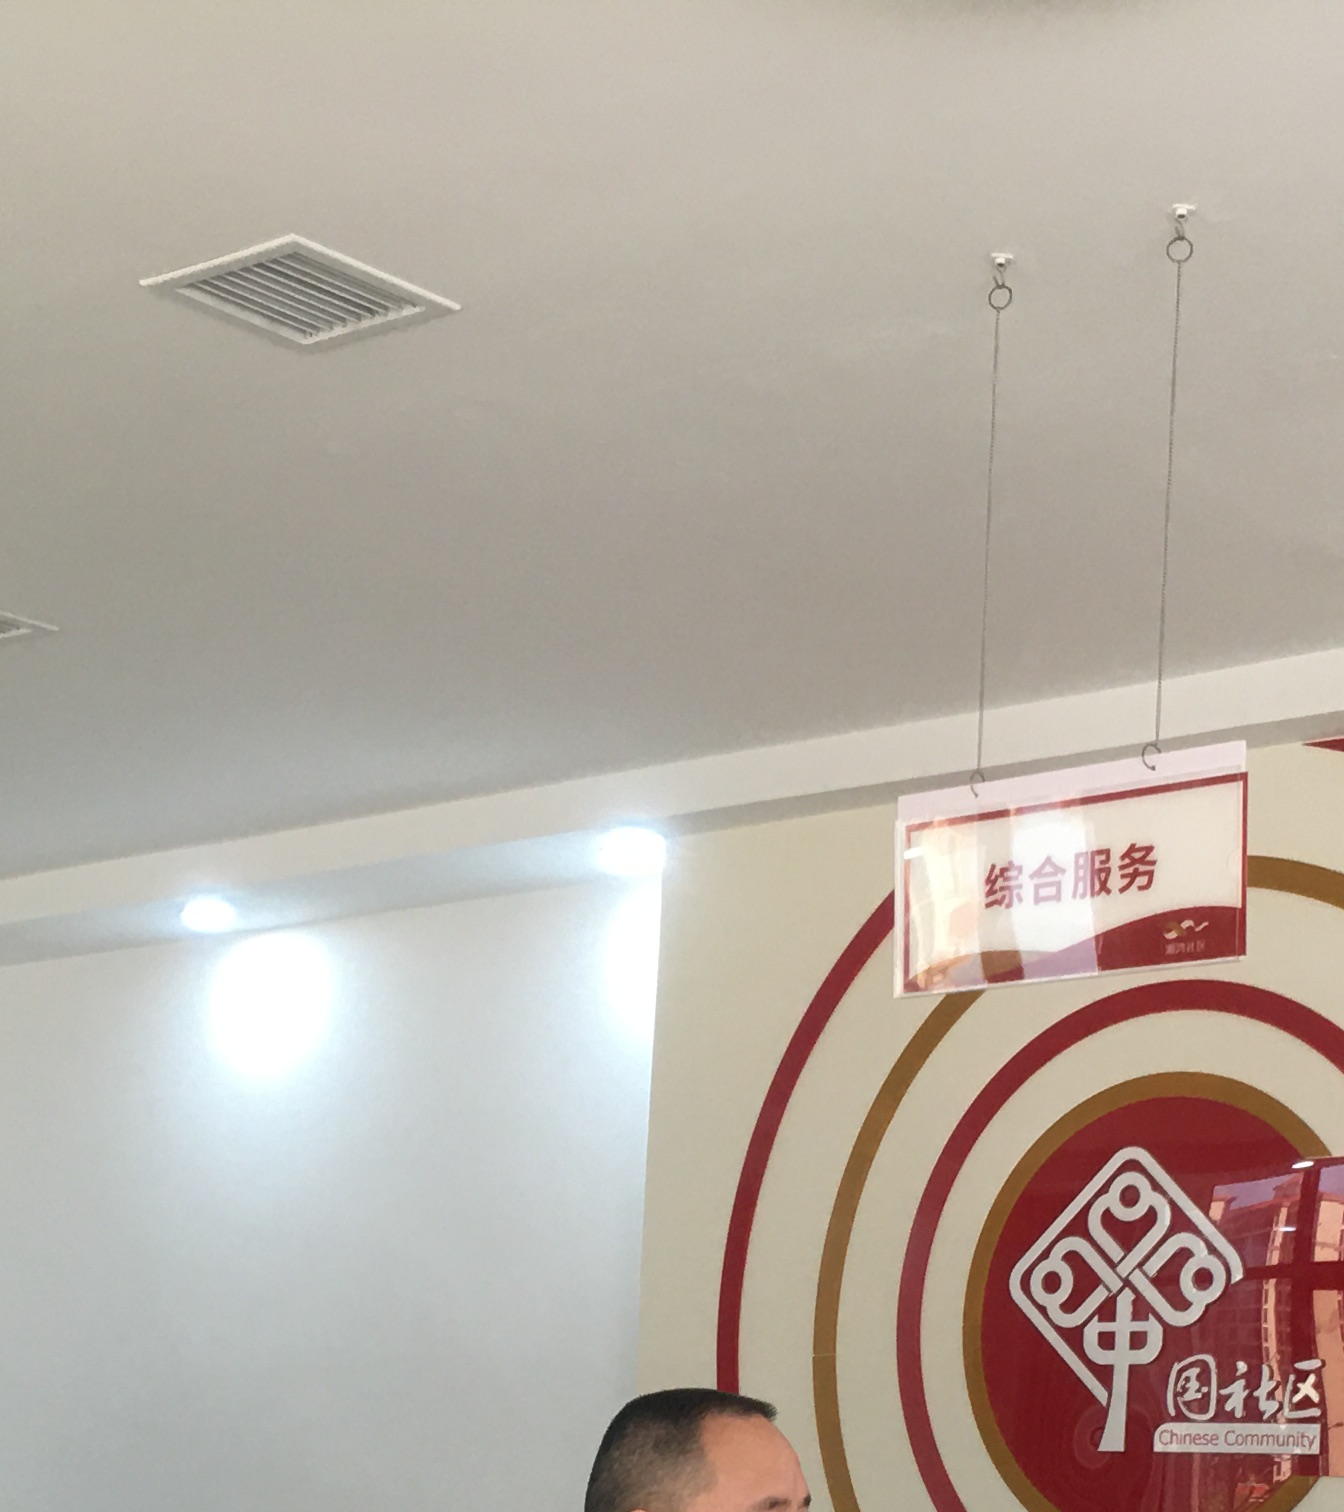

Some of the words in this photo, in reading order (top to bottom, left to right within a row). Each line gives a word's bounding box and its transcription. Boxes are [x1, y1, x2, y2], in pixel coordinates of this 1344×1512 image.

[984, 842, 1158, 910] 综合服务
[1158, 1428, 1219, 1446] Chinese
[1223, 1429, 1317, 1449] Community
